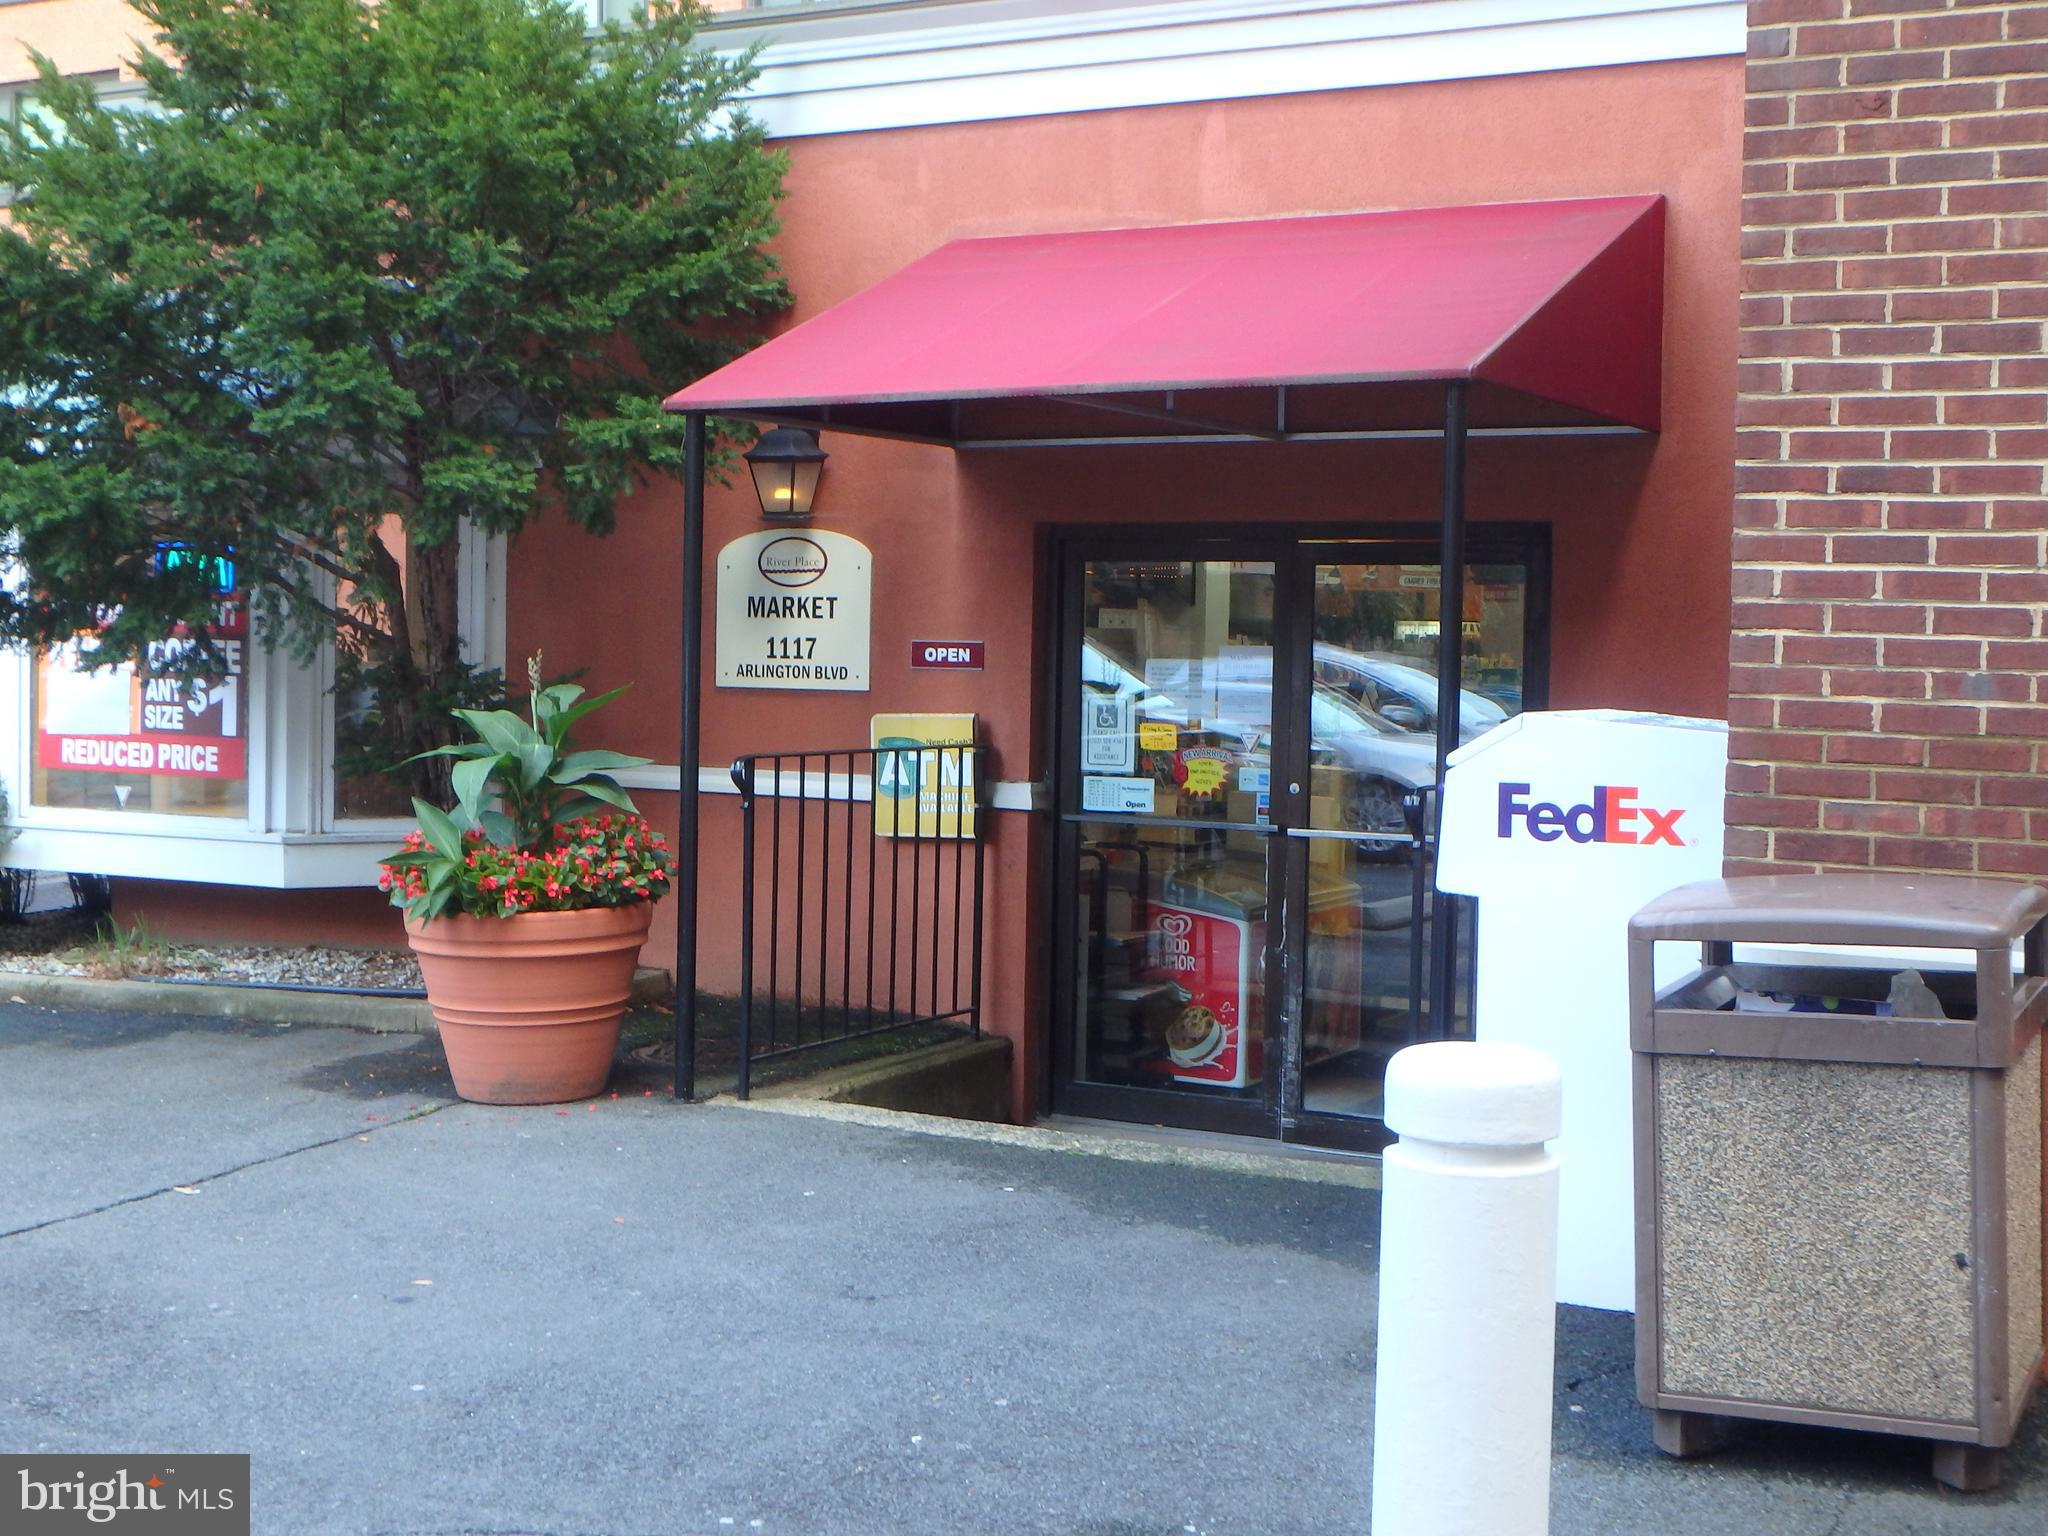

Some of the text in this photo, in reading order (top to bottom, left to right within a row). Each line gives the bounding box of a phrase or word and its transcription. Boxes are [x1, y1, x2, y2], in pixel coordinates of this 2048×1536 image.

[766, 556, 820, 567] River Place
[747, 596, 838, 619] MARKET
[766, 636, 817, 660] 1117
[924, 646, 971, 663] OPEN
[736, 664, 849, 680] ARLINGTON BLVD
[145, 678, 182, 702] ANY
[144, 704, 184, 730] SIZE
[926, 738, 945, 746] Need
[61, 738, 219, 772] REDUCED PRICE
[880, 751, 972, 787] ATM
[1125, 800, 1146, 808] Open
[1497, 782, 1687, 847] FedEx
